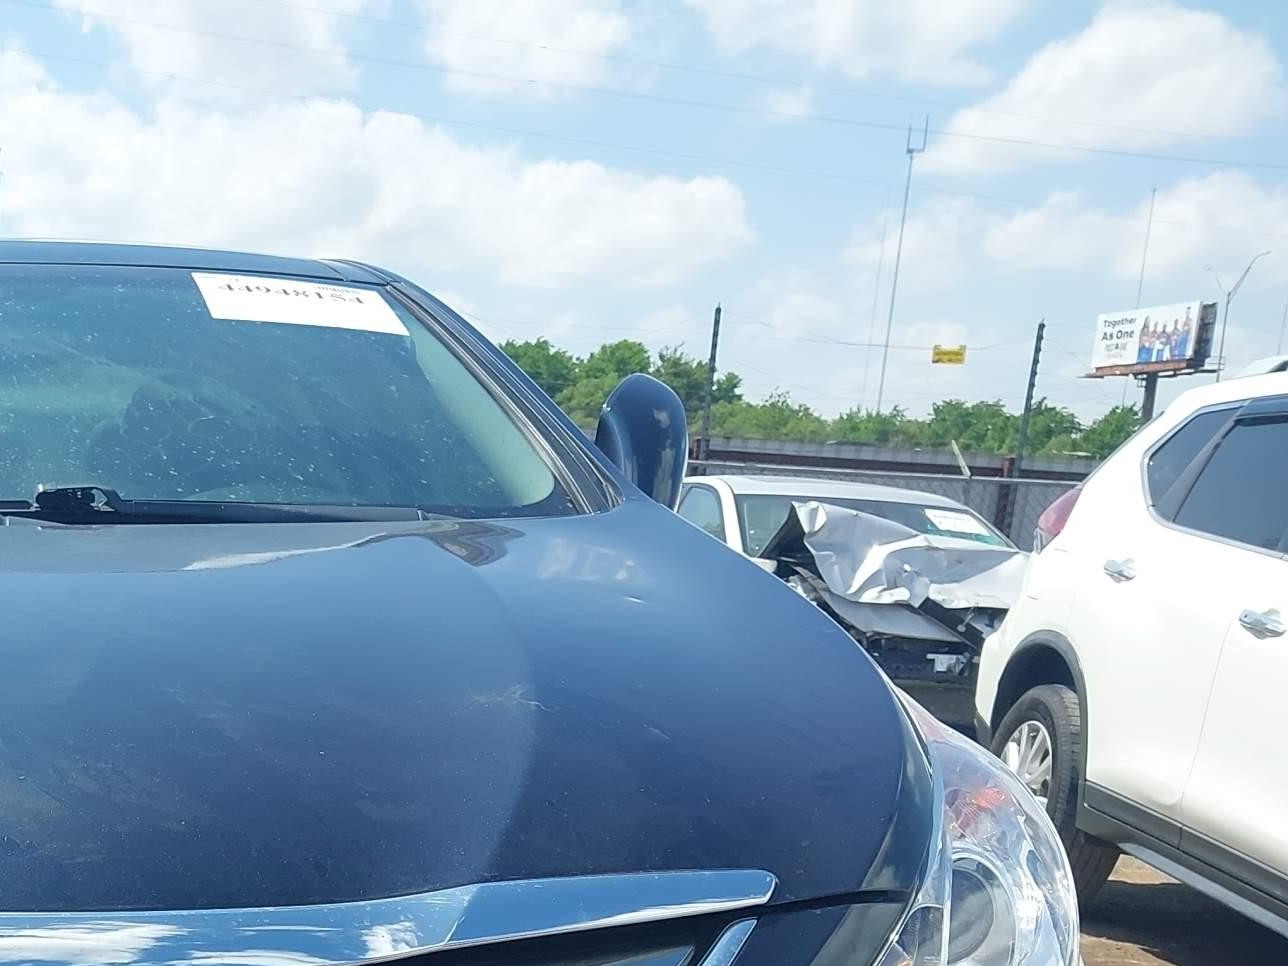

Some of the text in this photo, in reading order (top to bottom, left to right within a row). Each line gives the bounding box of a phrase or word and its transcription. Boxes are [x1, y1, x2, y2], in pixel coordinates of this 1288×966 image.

[1103, 317, 1137, 329] Together
[1101, 329, 1134, 341] As One
